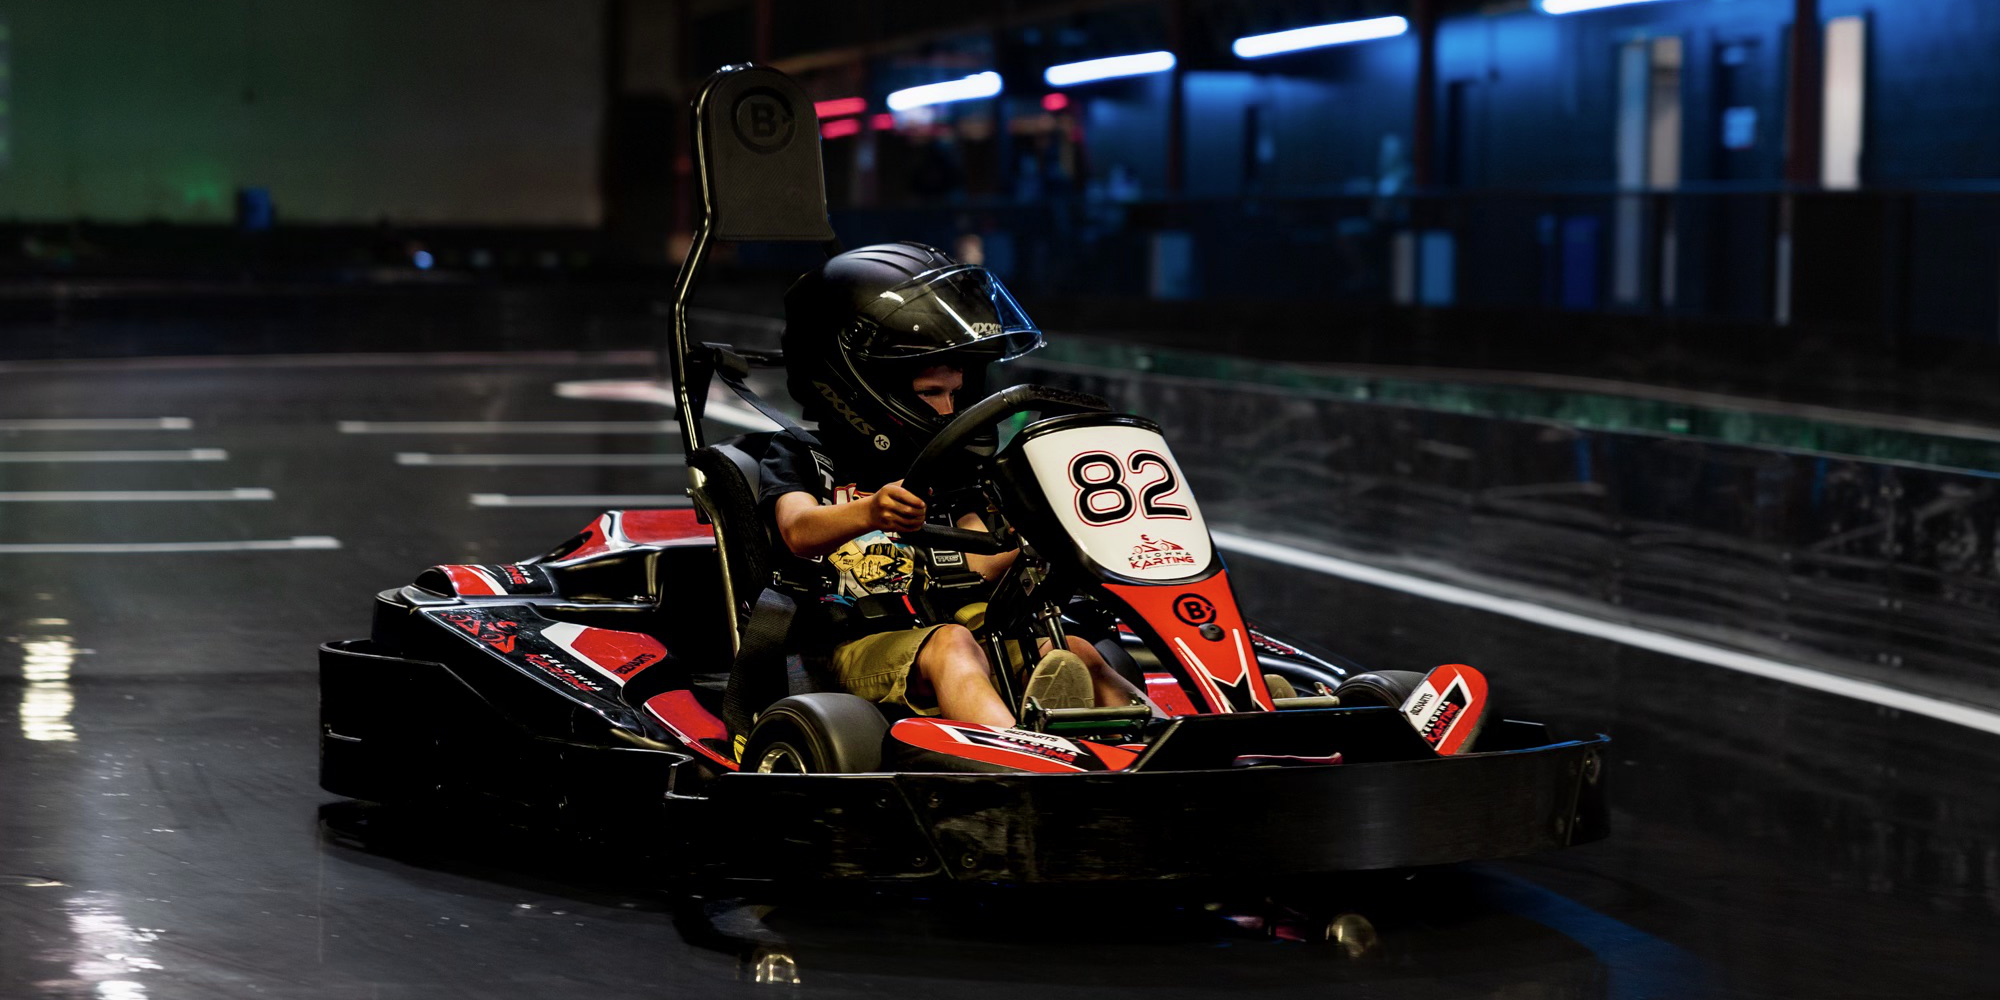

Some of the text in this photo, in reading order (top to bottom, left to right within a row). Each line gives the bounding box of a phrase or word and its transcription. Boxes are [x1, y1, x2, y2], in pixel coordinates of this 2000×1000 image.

[812, 379, 877, 436] AXXIS
[876, 436, 890, 450] XS
[1068, 449, 1192, 527] 82
[1128, 551, 1191, 562] KELOWNA
[1130, 556, 1195, 571] KARTING
[1184, 601, 1206, 620] B
[539, 653, 604, 692] KELOWNA
[1420, 700, 1452, 738] KELOWNA
[1425, 702, 1460, 743] KARTING
